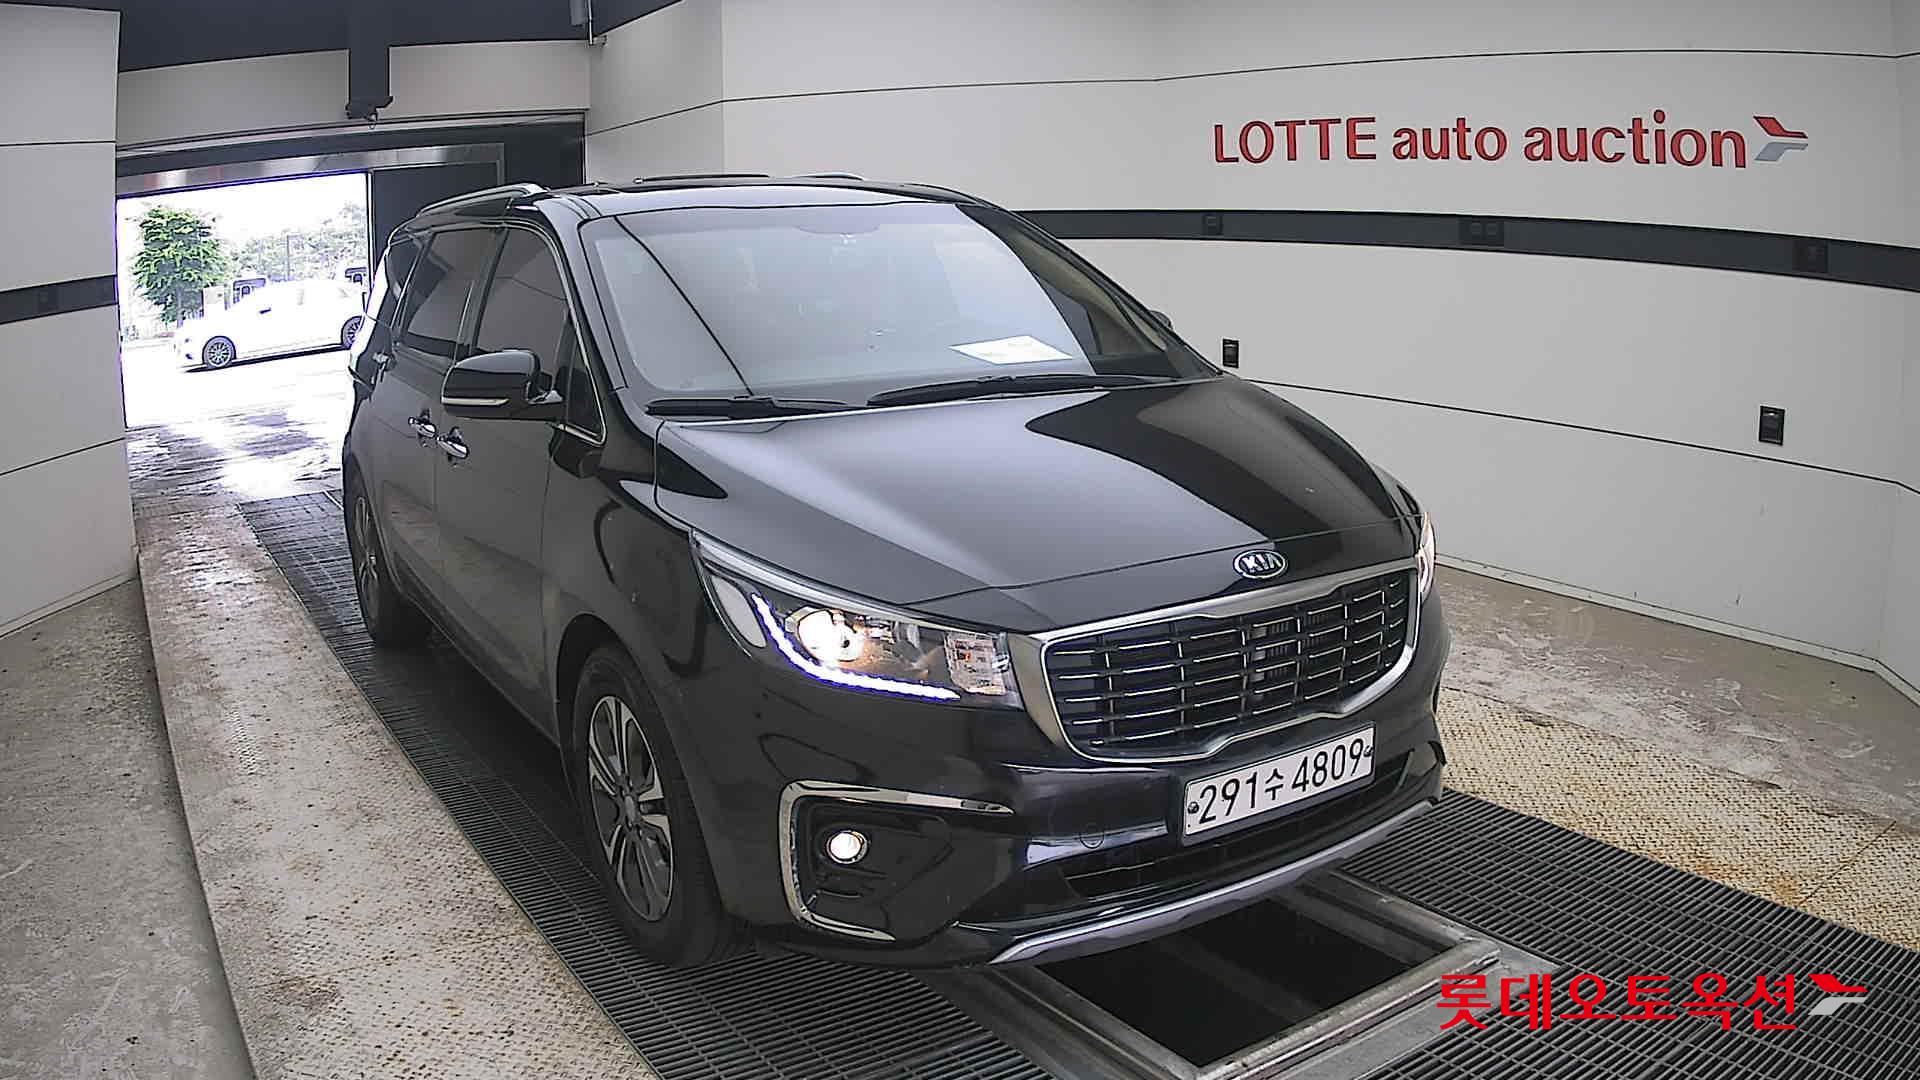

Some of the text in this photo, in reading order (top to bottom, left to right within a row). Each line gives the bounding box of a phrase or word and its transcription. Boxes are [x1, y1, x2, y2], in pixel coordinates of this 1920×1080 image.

[1214, 110, 1746, 168] LOTTE auto auction
[1240, 553, 1282, 573] KIA
